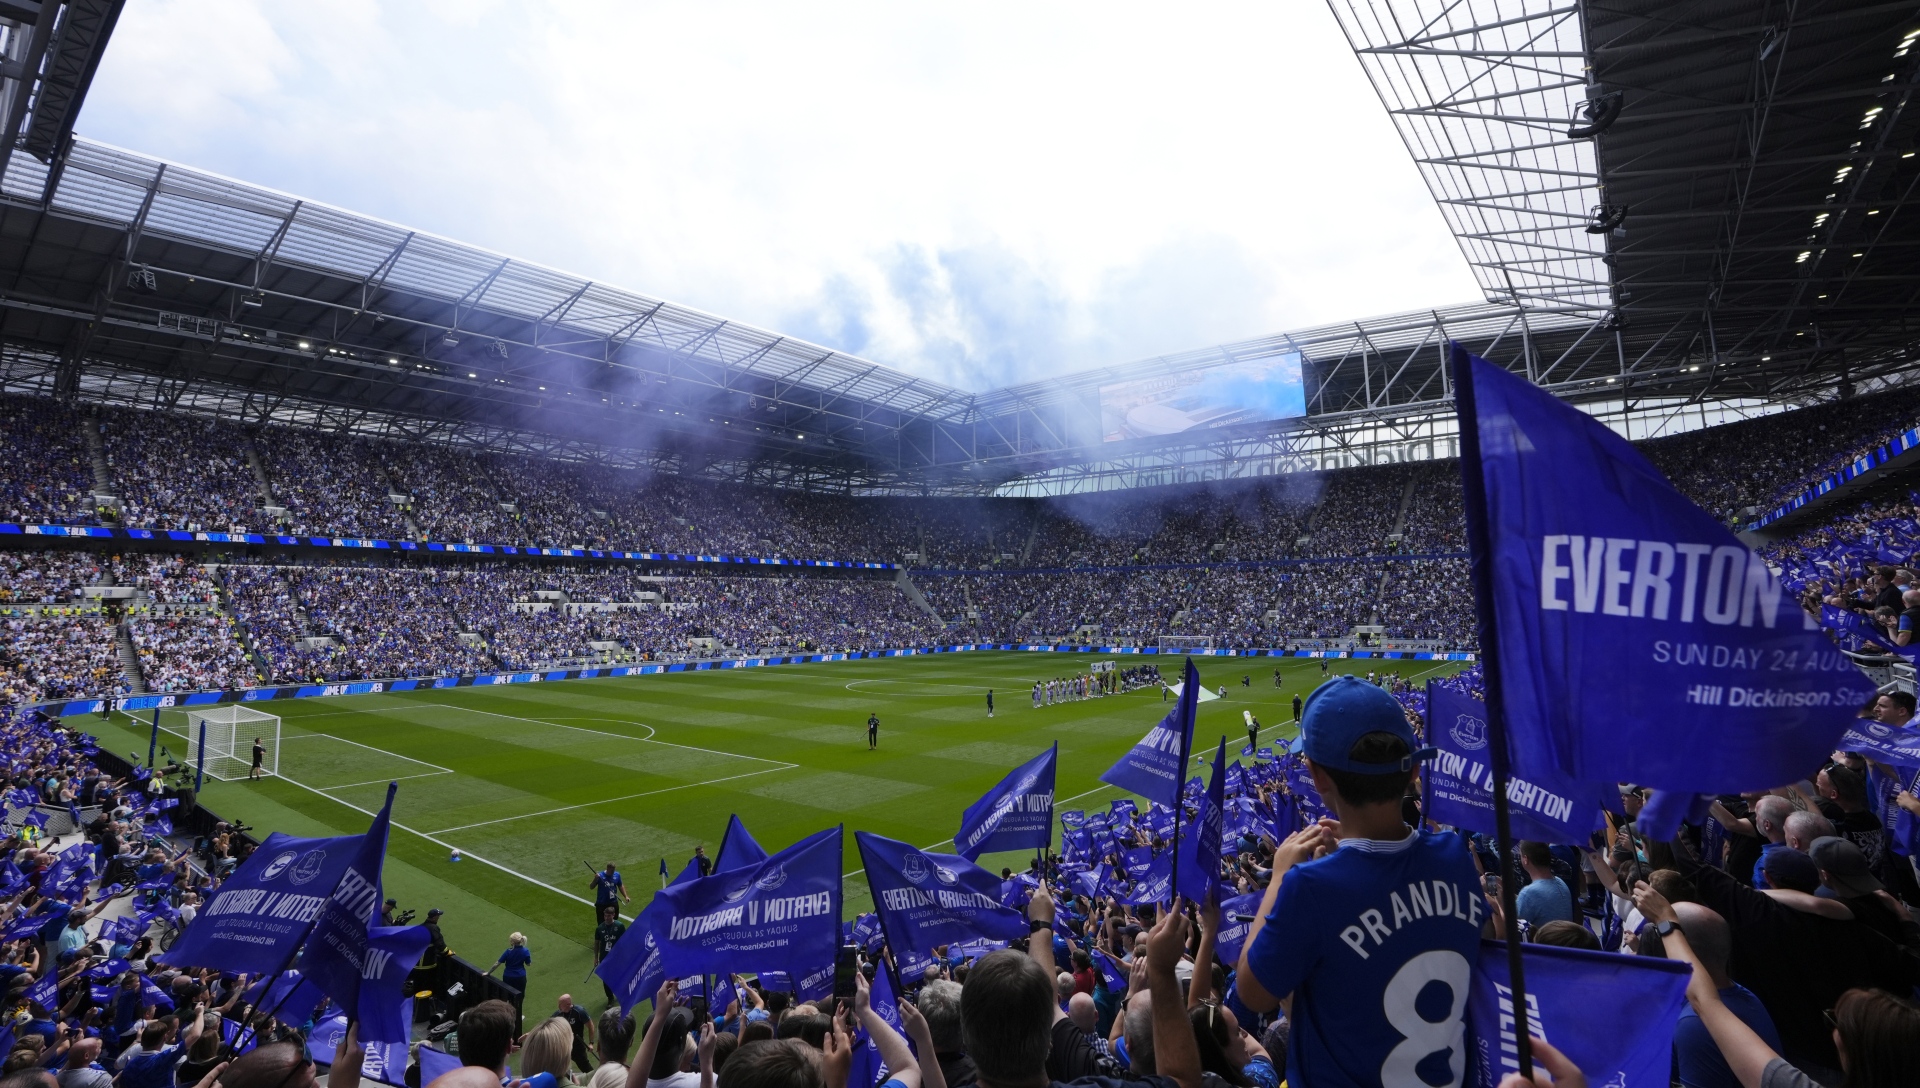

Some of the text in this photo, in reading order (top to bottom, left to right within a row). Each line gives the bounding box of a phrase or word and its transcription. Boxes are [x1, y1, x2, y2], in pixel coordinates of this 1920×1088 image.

[1541, 535, 1782, 630] EVERTON
[1653, 641, 1765, 673] SUNDAY
[1770, 650, 1797, 671] 24
[88, 699, 115, 713] HOE
[1687, 684, 1722, 706] Hill
[1728, 687, 1831, 708] Dickinson
[1434, 790, 1448, 800] Hill
[1448, 793, 1489, 810] Dickinson
[1468, 760, 1485, 785] V
[1483, 769, 1574, 823] BIGHTON
[909, 910, 935, 920] SUNDAY
[1340, 880, 1483, 959] PRANDLE
[323, 931, 365, 974] Hill Dickinso
[1380, 950, 1471, 1088] 8
[1476, 1036, 1493, 1088] SUNDA
